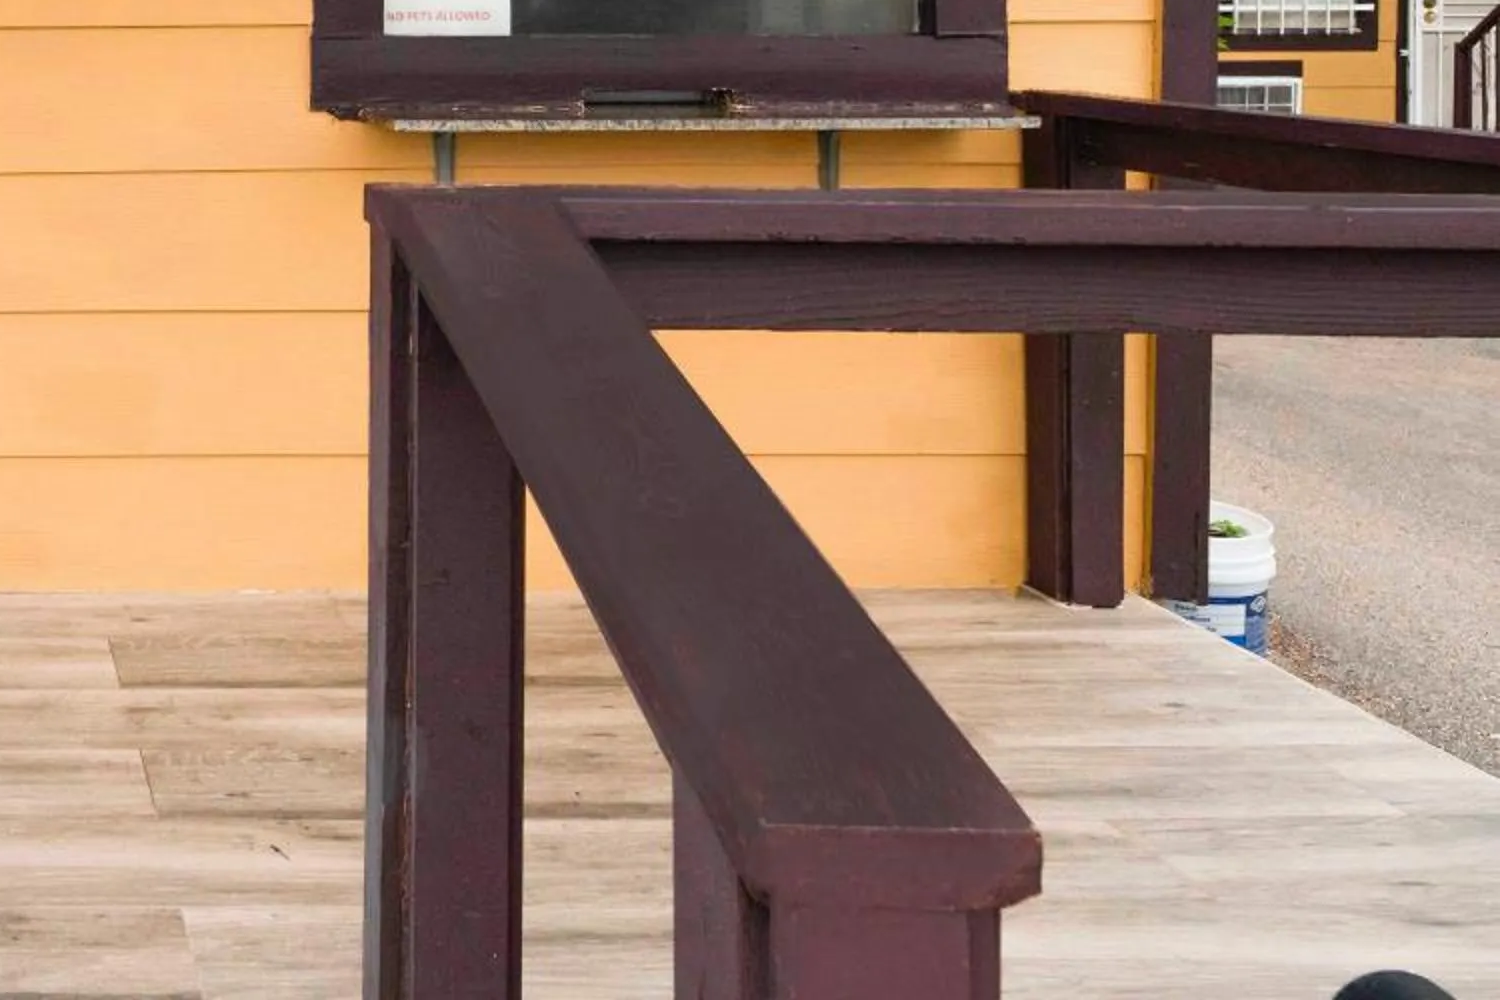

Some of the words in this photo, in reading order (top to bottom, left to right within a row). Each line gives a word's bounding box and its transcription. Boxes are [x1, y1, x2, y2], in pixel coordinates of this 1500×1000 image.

[387, 11, 404, 21] NO
[407, 11, 432, 21] PETS
[435, 10, 492, 22] ALLOWED
